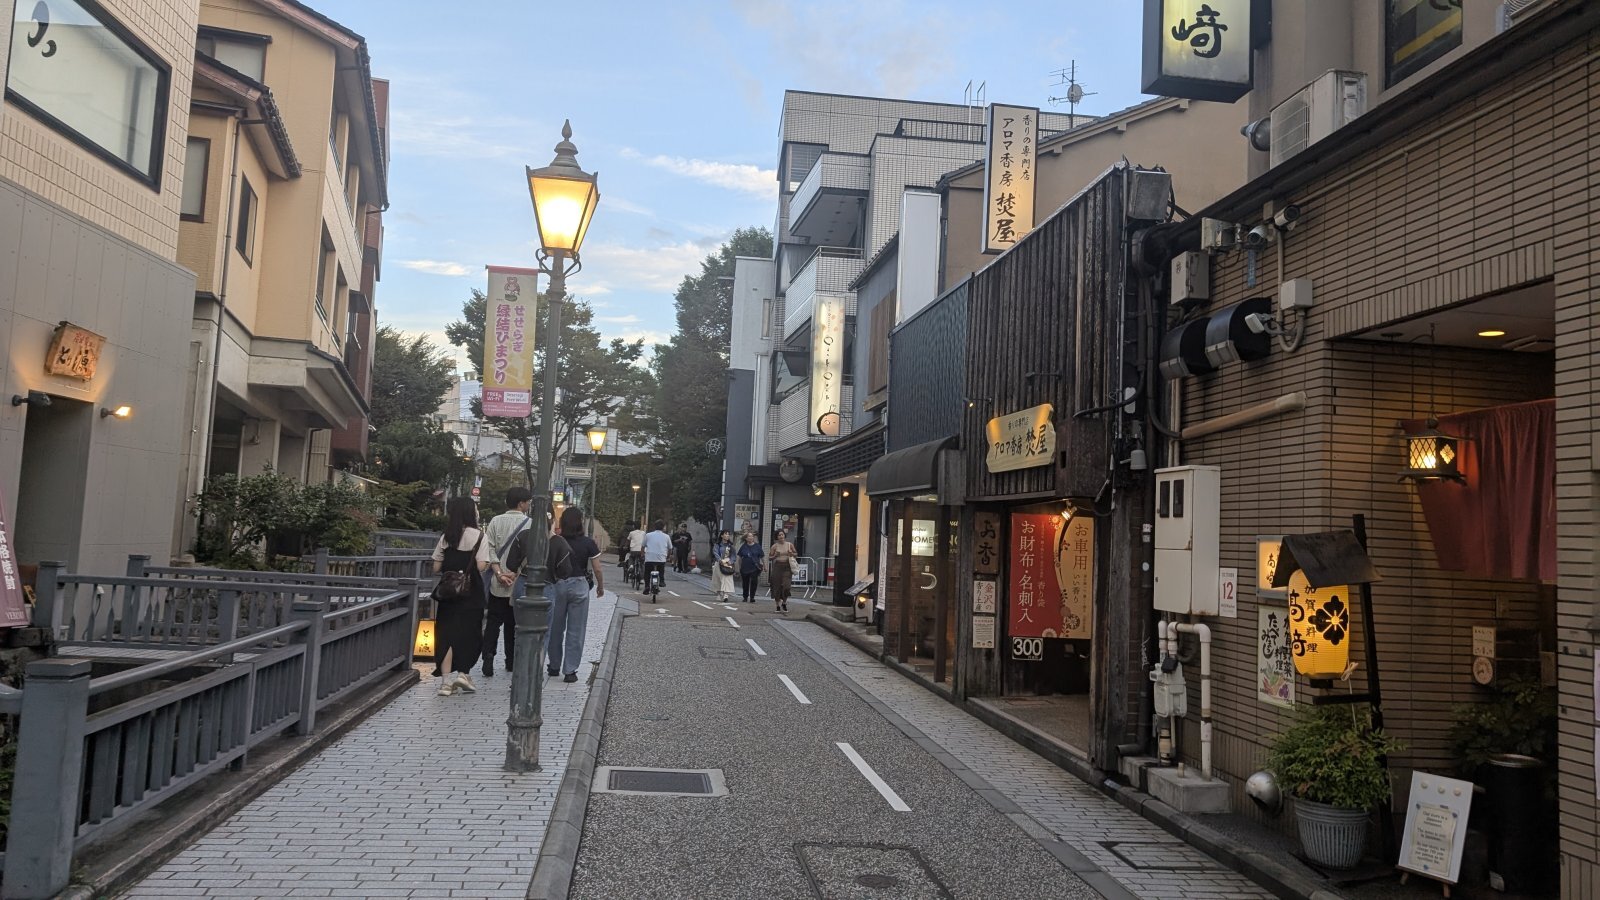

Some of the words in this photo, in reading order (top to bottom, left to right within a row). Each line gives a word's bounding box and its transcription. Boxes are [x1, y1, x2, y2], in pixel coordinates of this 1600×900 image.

[998, 117, 1015, 187] アロマ香房
[1020, 114, 1032, 181] 香りの専門店
[991, 192, 1017, 244] 焚屋
[513, 305, 526, 353] せせらぎ
[994, 434, 1023, 460] アロマ香房
[1025, 423, 1048, 457] 焚屋
[977, 519, 998, 566] お香
[1072, 522, 1089, 571] お車用
[1017, 520, 1036, 623] お財布・名刺入
[1072, 574, 1081, 604] いい香り
[1222, 581, 1234, 600] 12
[983, 582, 994, 611] 金沢の
[1304, 585, 1319, 654] 加賀料理
[1013, 638, 1042, 656] 300
